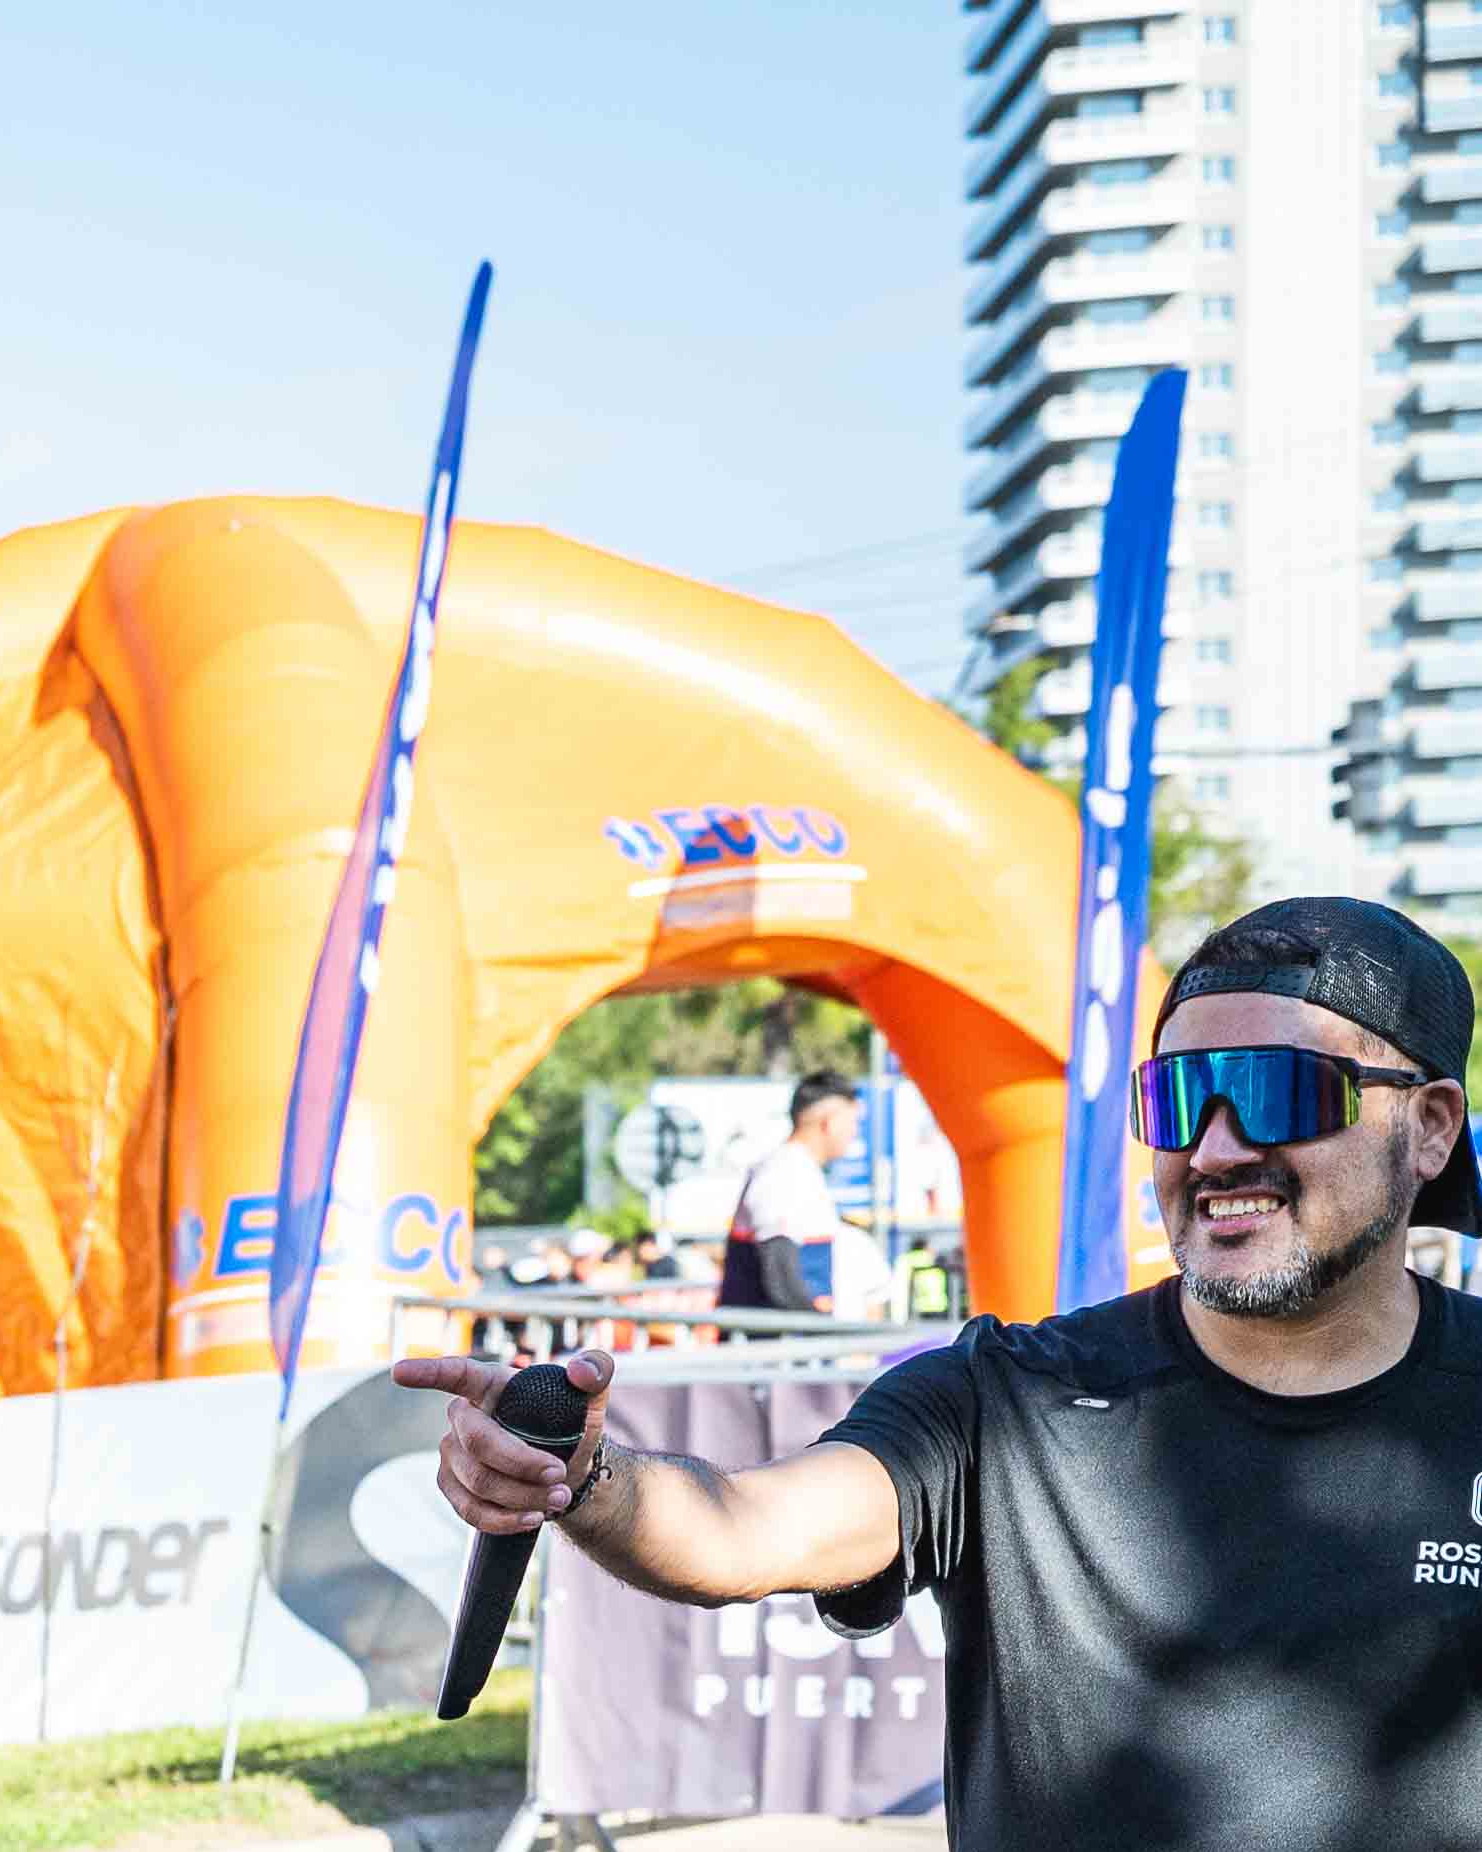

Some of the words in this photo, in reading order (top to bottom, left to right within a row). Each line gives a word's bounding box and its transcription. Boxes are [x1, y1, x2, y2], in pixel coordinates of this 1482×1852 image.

[658, 806, 846, 865] ECCO
[1418, 1541, 1482, 1563] ROS
[692, 1674, 927, 1720] PUERT
